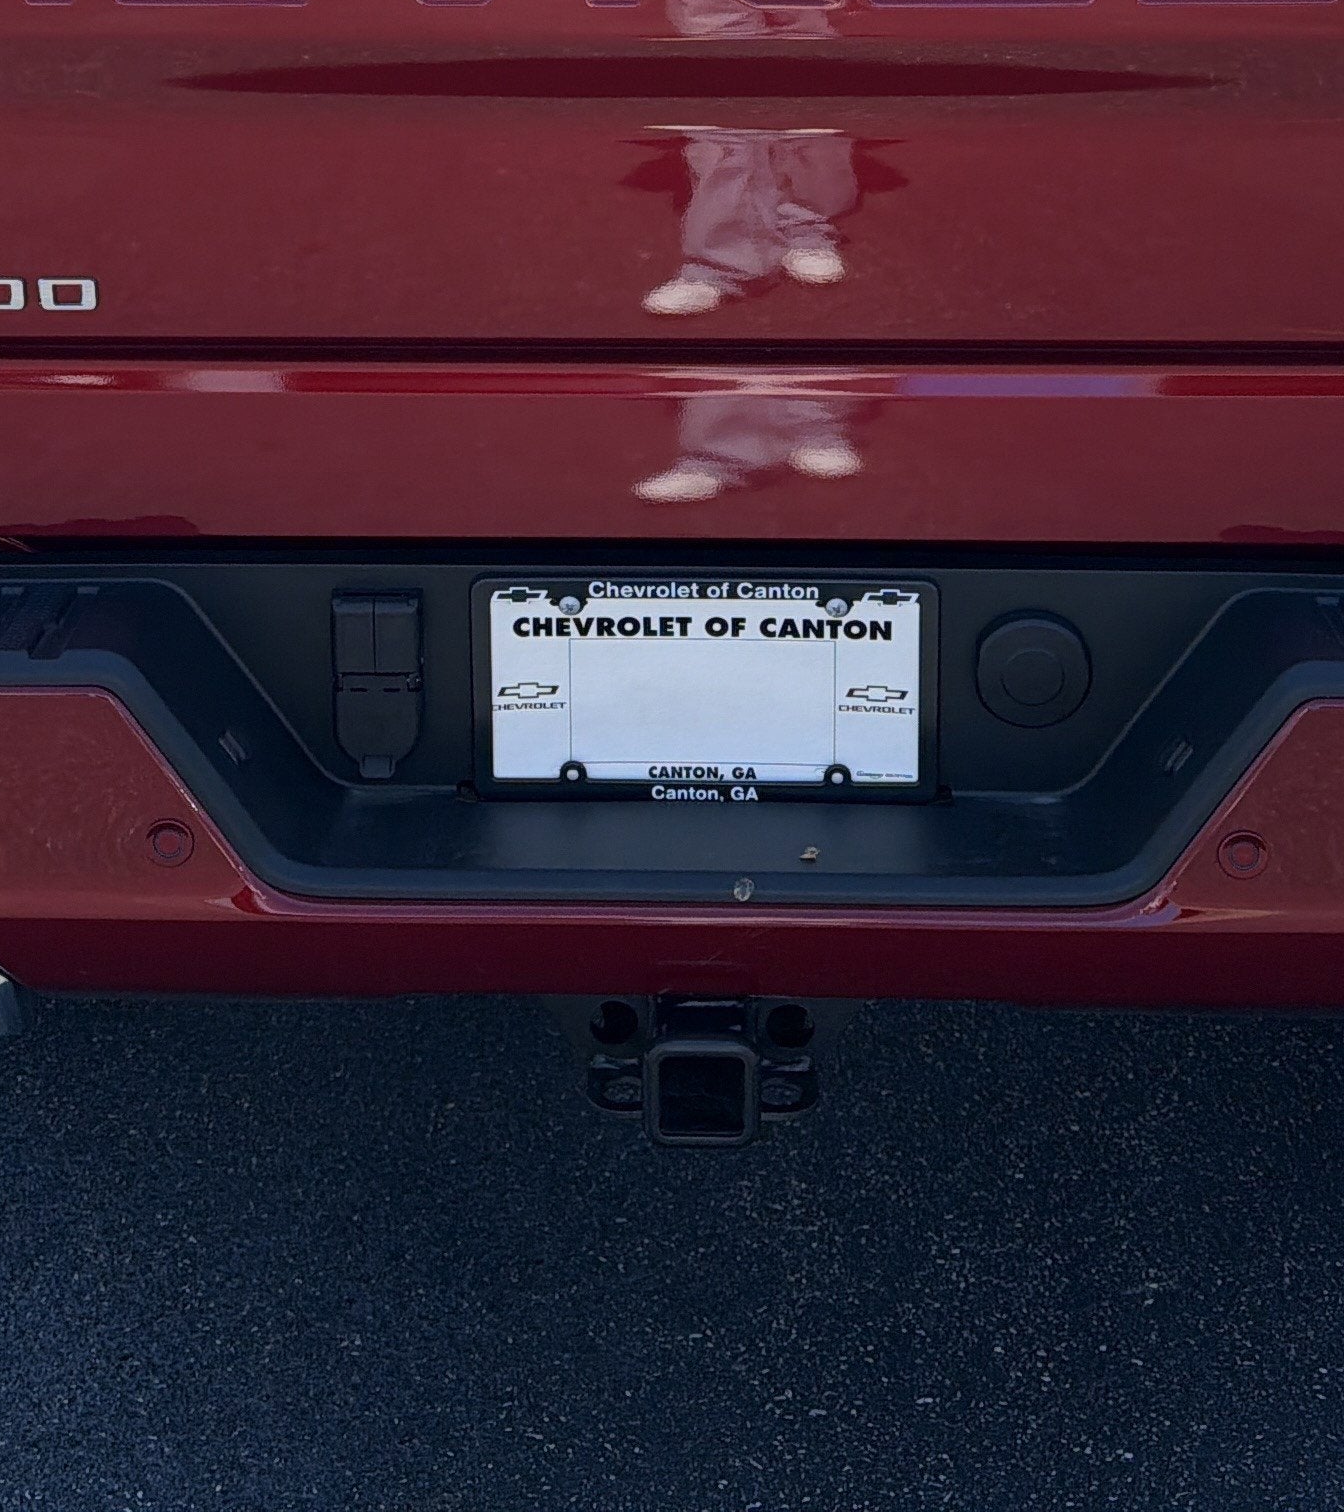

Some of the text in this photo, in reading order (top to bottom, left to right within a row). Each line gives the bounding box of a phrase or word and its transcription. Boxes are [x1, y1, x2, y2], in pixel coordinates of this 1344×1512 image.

[588, 581, 820, 601] Chevrolet of Canton
[512, 616, 893, 641] CHEVROLET OF CANTON
[492, 701, 568, 712] CHEVROLET
[838, 704, 916, 715] CHEVROLET
[648, 765, 757, 781] CANTON, GA
[651, 785, 759, 802] Canton, GA
